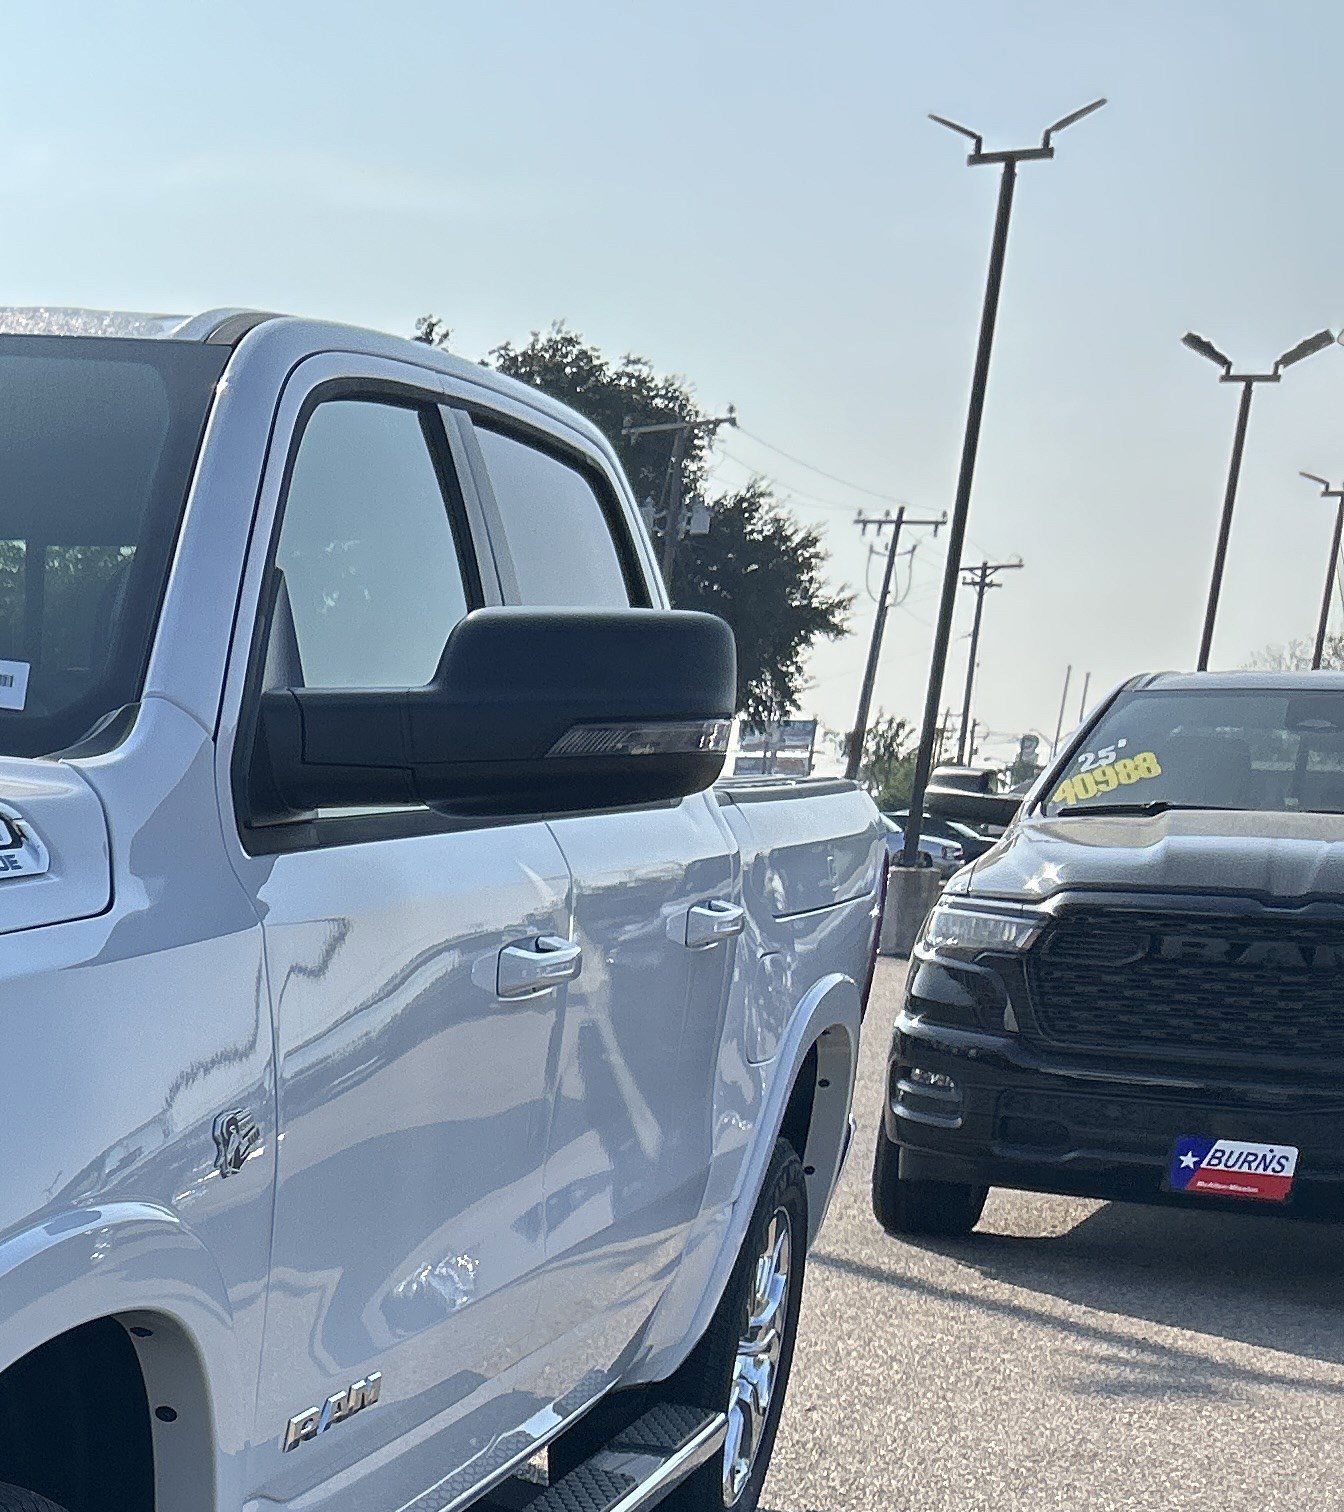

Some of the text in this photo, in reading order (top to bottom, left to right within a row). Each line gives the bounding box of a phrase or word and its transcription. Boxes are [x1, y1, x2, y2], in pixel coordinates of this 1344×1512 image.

[1052, 751, 1161, 805] 40988
[1206, 1148, 1289, 1174] BURNS
[283, 1371, 382, 1453] RAM
